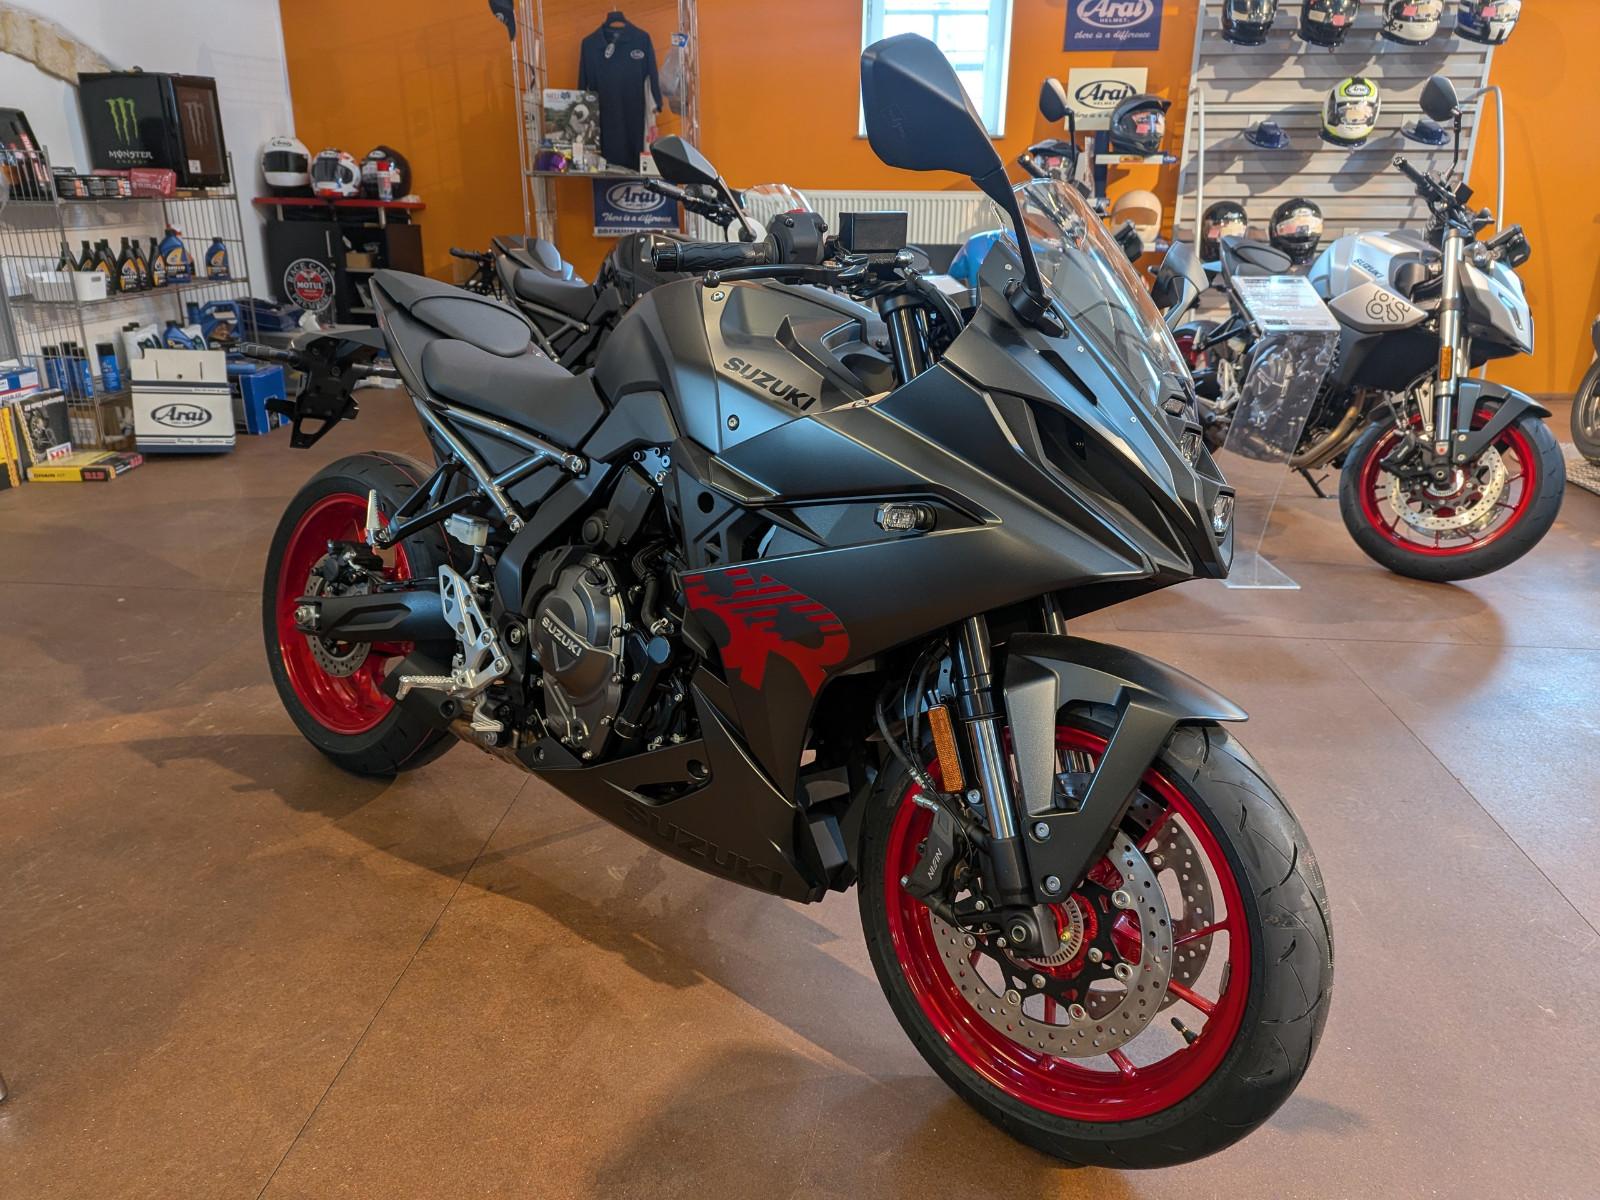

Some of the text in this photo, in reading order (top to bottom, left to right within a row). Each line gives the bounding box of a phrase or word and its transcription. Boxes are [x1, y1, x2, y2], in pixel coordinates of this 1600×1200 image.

[1080, 83, 1129, 101] Arai
[108, 150, 154, 159] MONSTER
[296, 282, 323, 290] MOTUL
[723, 357, 817, 411] SUZUKI
[155, 406, 204, 421] Arai
[541, 616, 582, 657] SUZUKI
[624, 801, 784, 893] SUZUKI
